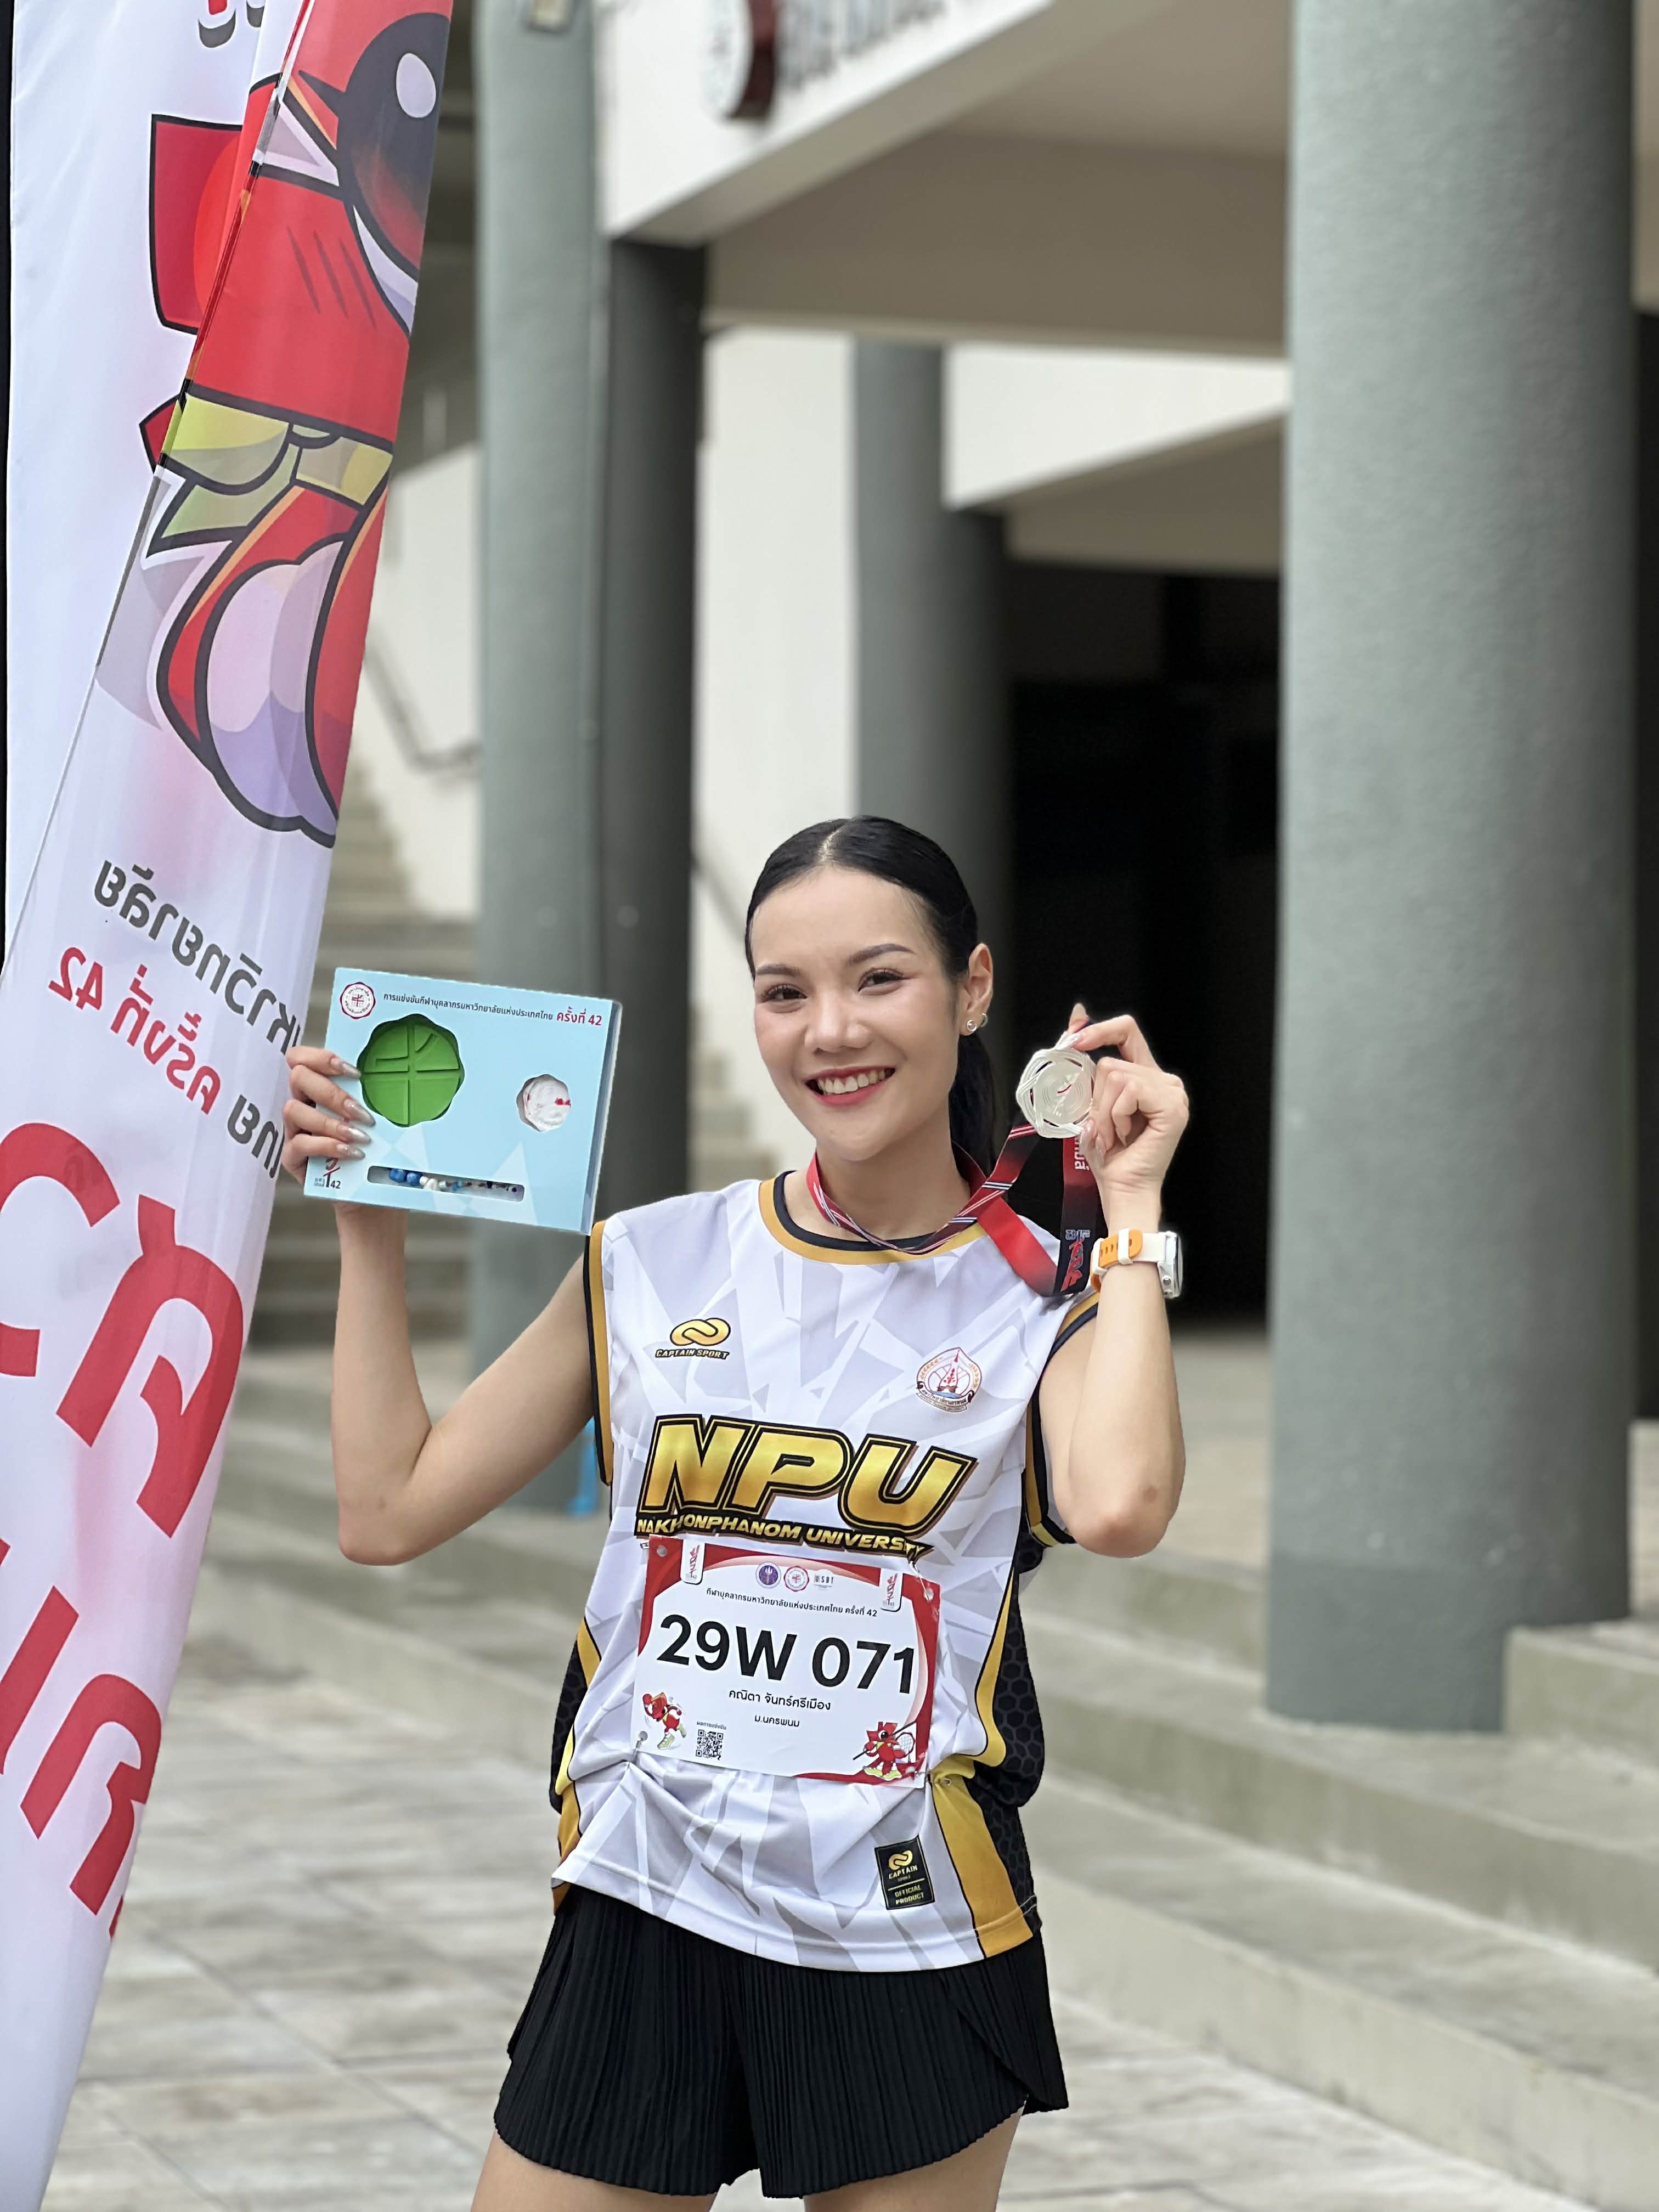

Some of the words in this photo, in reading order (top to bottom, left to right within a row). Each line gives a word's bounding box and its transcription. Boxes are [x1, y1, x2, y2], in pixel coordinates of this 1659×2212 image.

[556, 1006, 586, 1024] ครั้งที่
[588, 1014, 602, 1026] 42
[330, 1180, 341, 1189] 42
[656, 1348, 695, 1357] CAPTAIN
[696, 1349, 729, 1359] SPORT
[636, 1415, 977, 1534] NPU
[706, 1588, 843, 1613] กีฬาบุคลากรมหาวิทยาลัยแห่งประเทศไทย
[845, 1605, 865, 1616] ครั้งที่
[866, 1609, 878, 1617] 42
[657, 1613, 798, 1682] 29W
[811, 1637, 915, 1694] 071
[764, 1692, 831, 1711] จันทร์ศรีเมือง
[754, 1715, 800, 1728] ม.นครพนม
[888, 1865, 918, 1879] CAPTAIN
[894, 1884, 922, 1898] OFFICIAL
[895, 1892, 924, 1905] PRODUCT
